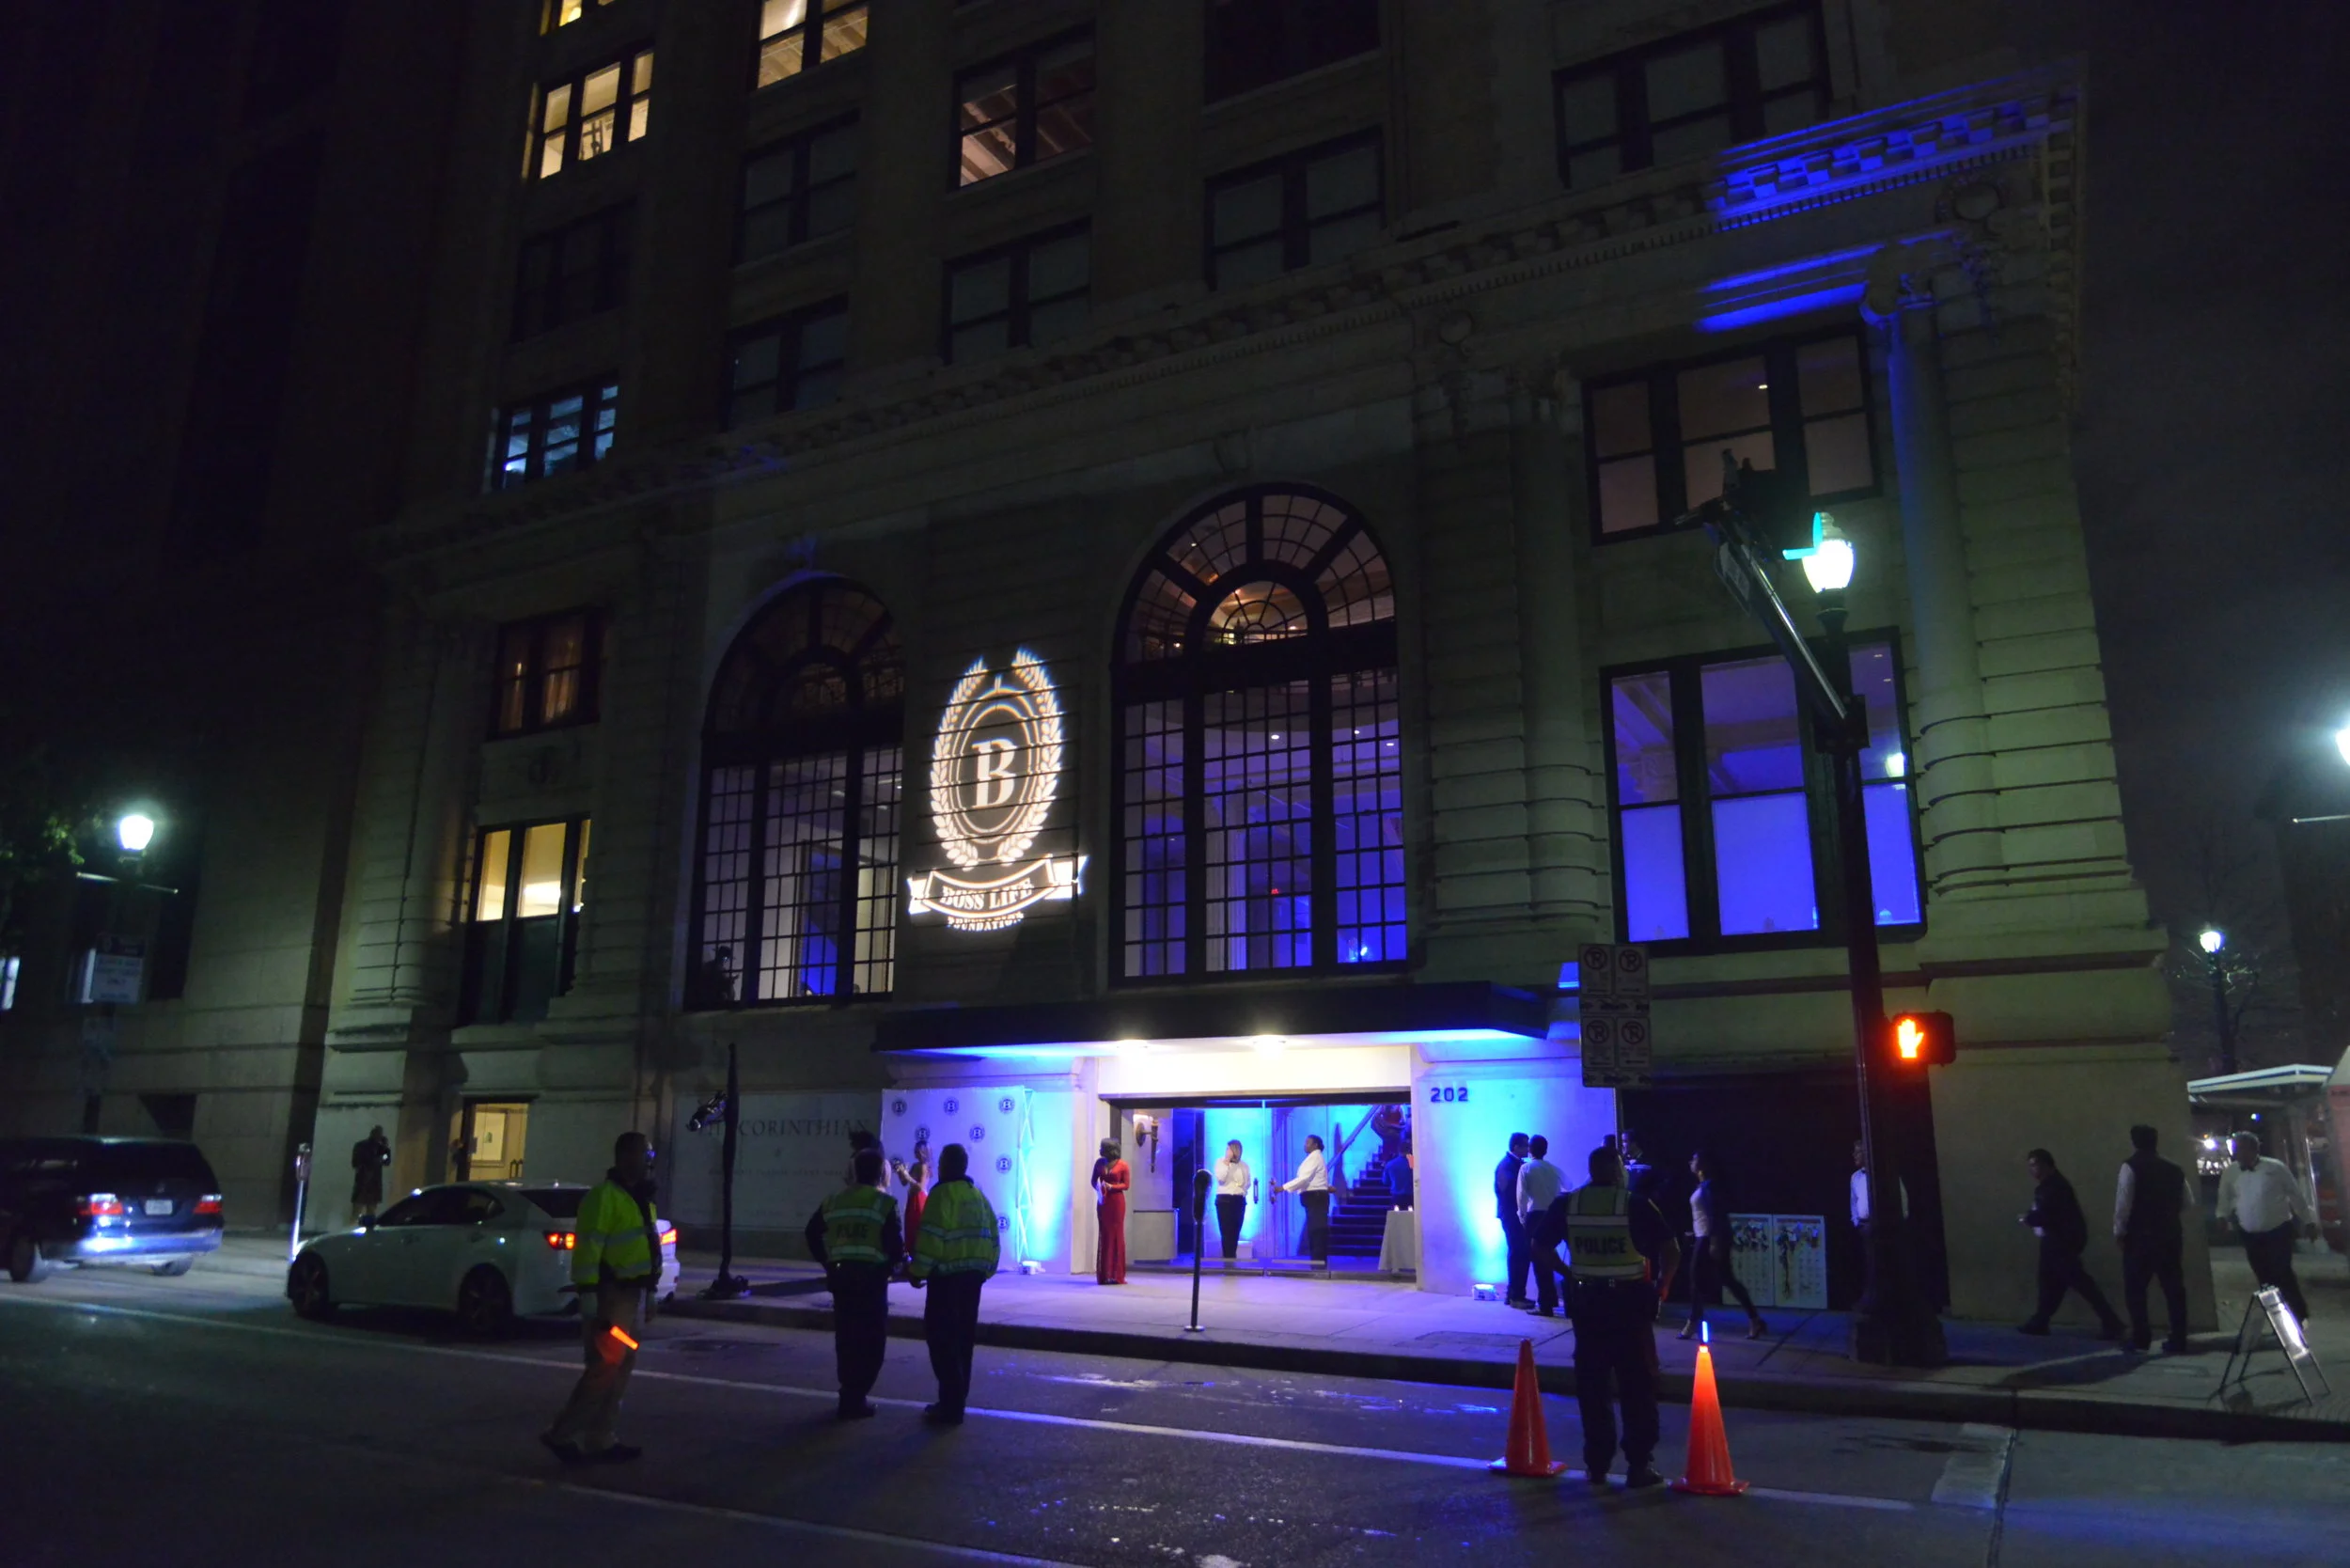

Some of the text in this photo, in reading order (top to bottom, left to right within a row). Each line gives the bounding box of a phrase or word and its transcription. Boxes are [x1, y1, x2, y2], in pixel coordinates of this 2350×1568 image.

[971, 737, 1018, 808] B
[940, 877, 1033, 910] BOSS LIFE
[948, 911, 1025, 932] FOUNDATION
[1430, 1087, 1468, 1103] 202
[739, 1118, 869, 1137] CORINTHIAN
[1574, 1235, 1626, 1255] POLICE
